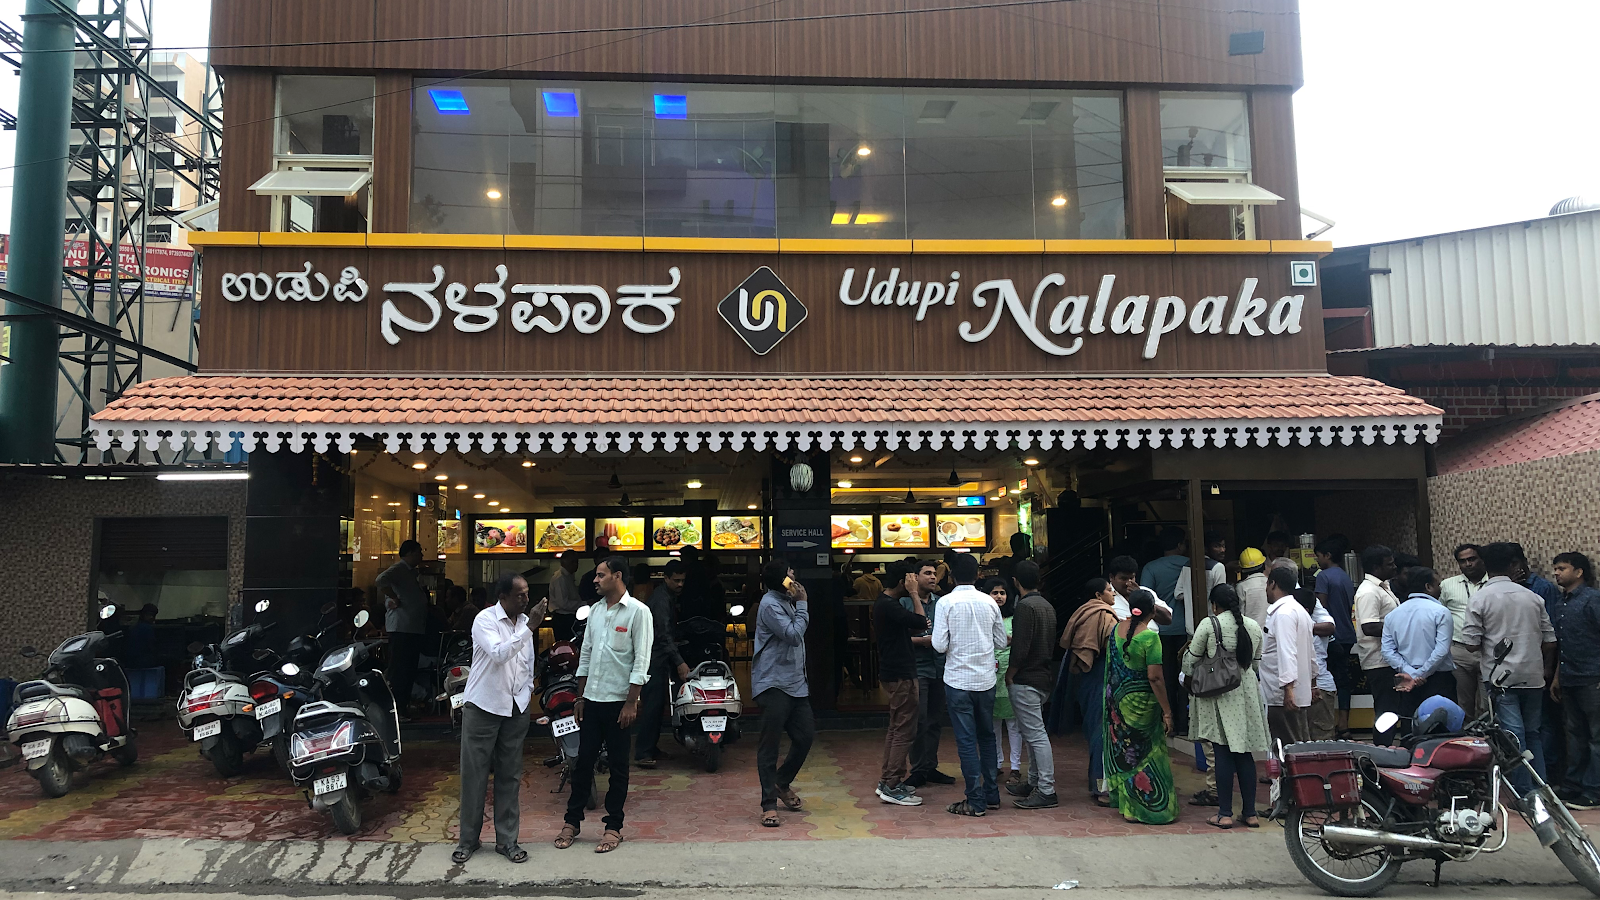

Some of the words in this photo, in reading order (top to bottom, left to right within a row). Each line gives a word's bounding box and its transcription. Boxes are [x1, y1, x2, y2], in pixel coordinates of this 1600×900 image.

[222, 262, 368, 302] ಉಡುಪಿ
[381, 264, 682, 345] ನಳಪಾಕ
[839, 267, 961, 321] Udupi
[958, 272, 1305, 359] Nalapaka
[781, 529, 807, 537] SERVICE
